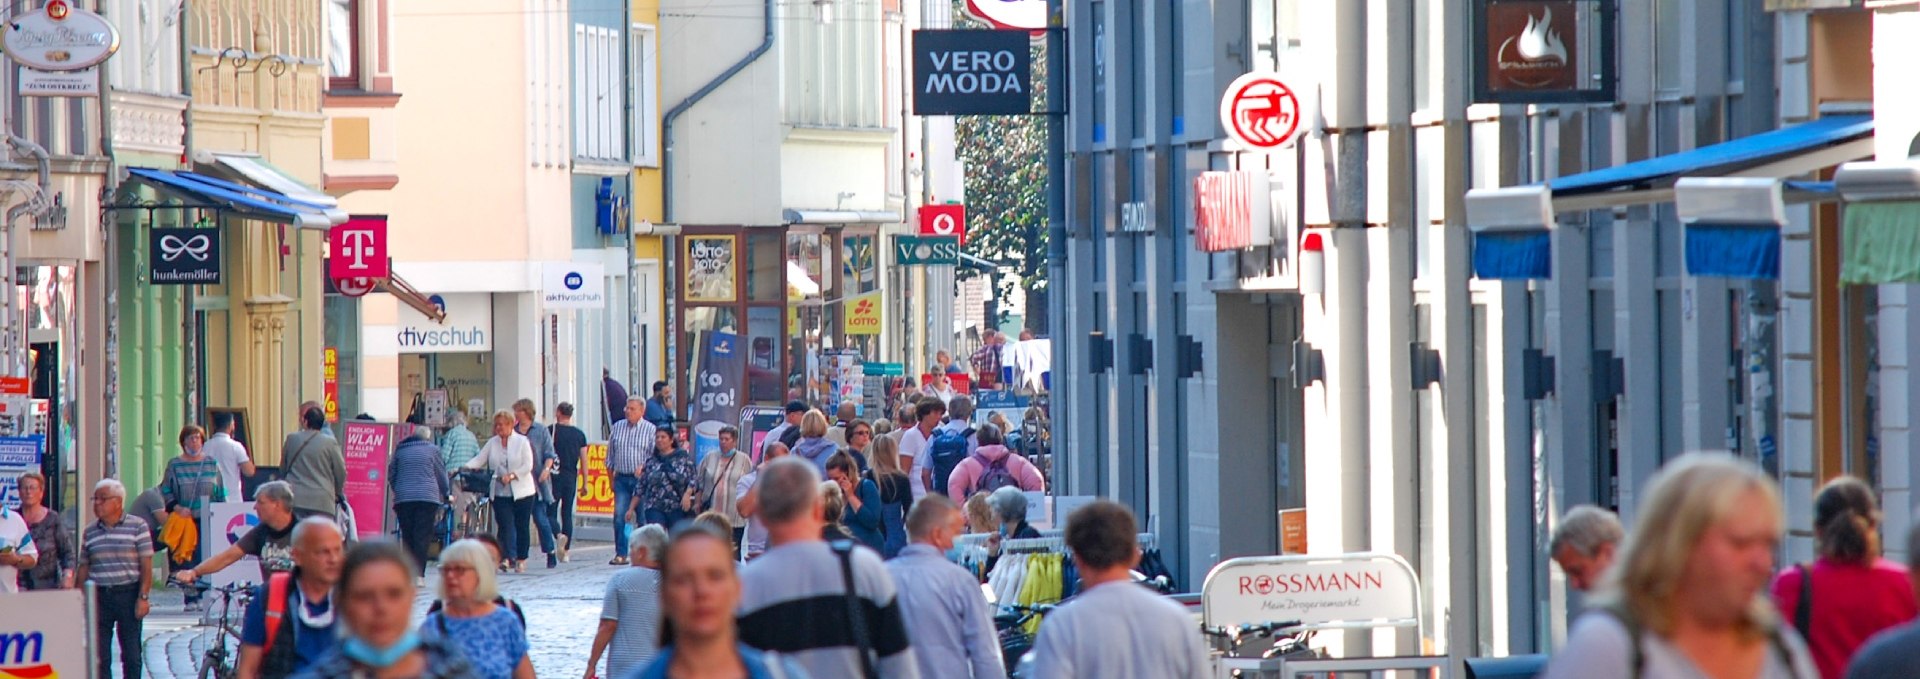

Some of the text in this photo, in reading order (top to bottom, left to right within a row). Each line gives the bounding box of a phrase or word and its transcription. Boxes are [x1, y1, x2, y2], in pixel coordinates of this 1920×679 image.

[929, 50, 1015, 71] VERO
[925, 73, 1022, 93] MODA
[342, 229, 375, 269] T
[153, 268, 219, 281] hunkemöller
[545, 292, 602, 302] aktivschuh
[848, 318, 878, 326] LOTTO
[701, 369, 723, 388] to
[700, 388, 735, 413] go!
[347, 434, 384, 446] WLAN
[346, 451, 368, 459] ECKEN
[1238, 569, 1383, 596] ROSSMANN
[1286, 597, 1361, 613] Drogeriemarkt
